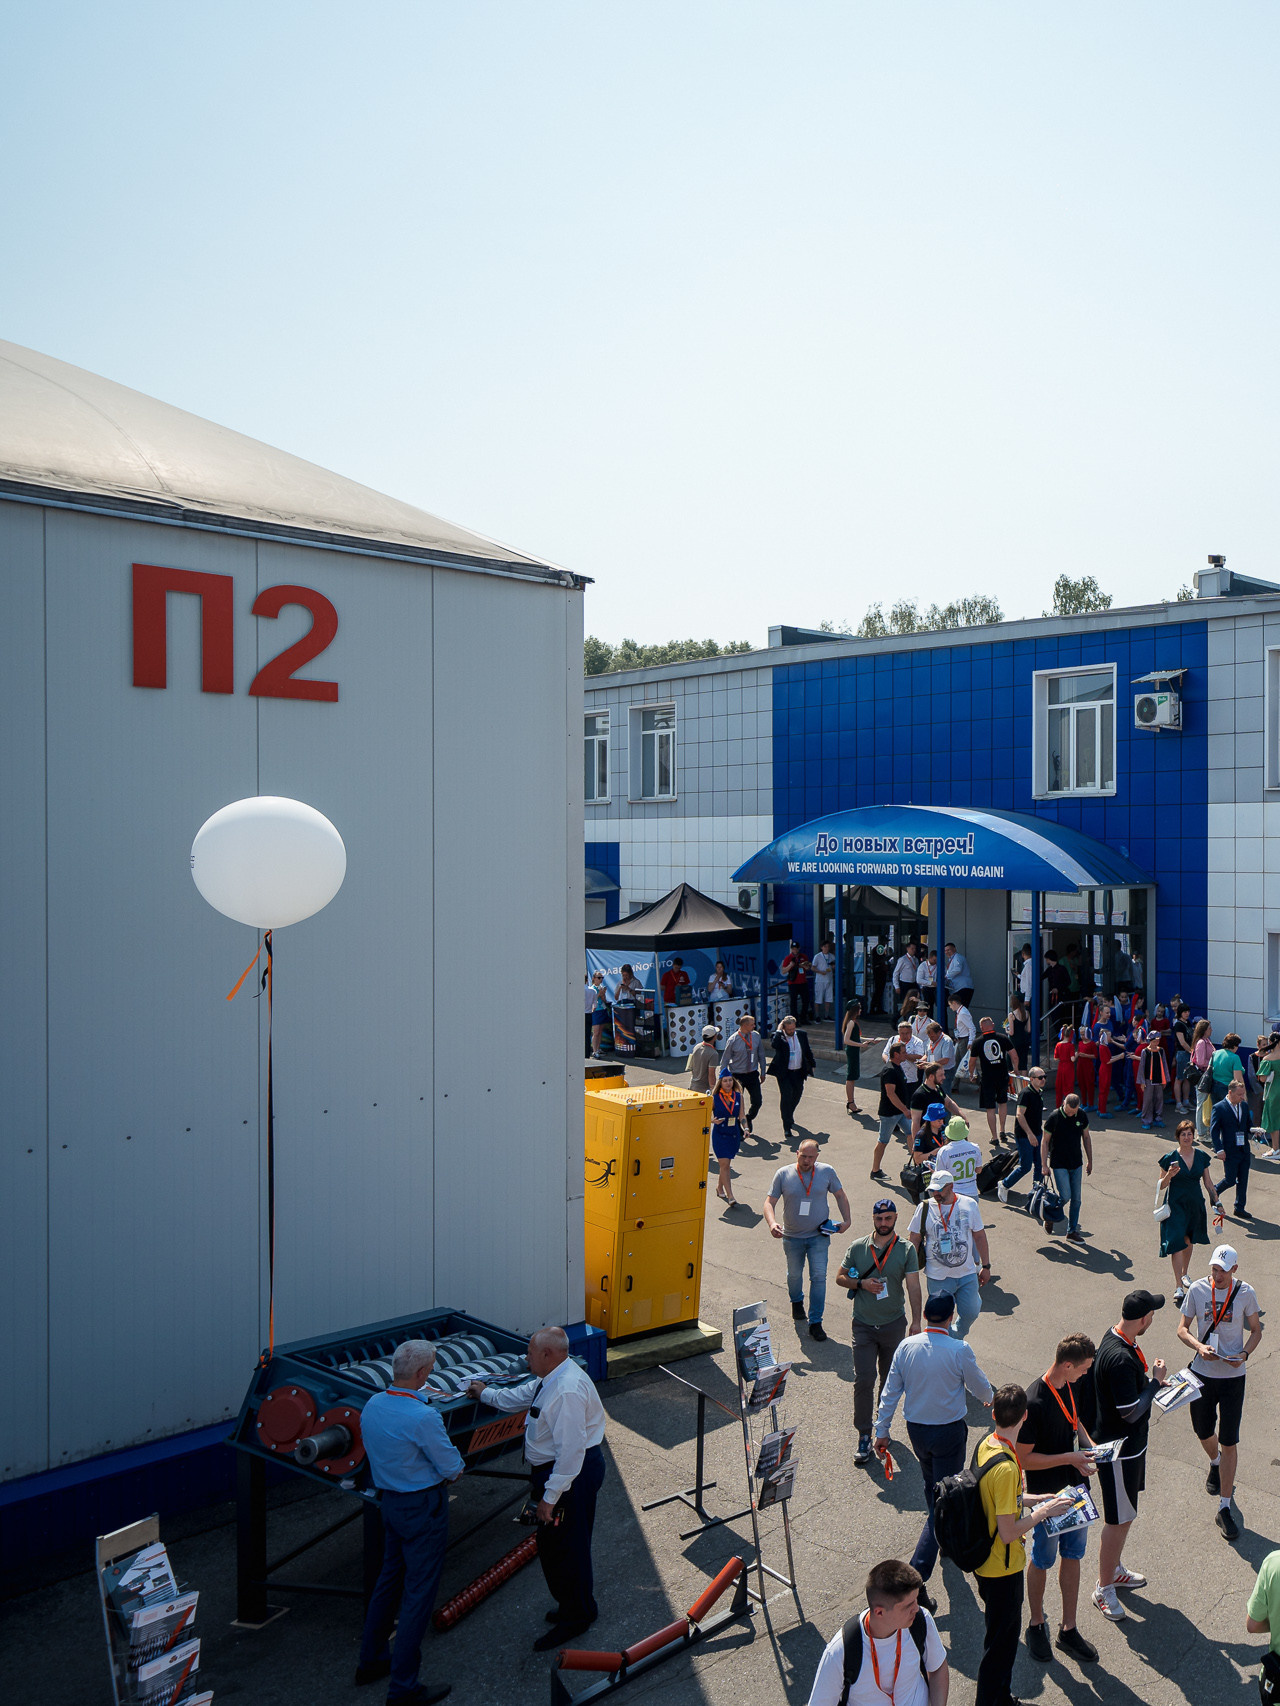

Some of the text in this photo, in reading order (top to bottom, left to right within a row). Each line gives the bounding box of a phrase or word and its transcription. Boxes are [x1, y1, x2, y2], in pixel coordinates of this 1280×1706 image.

[131, 563, 339, 702] П2
[815, 832, 975, 860] До новых встреч!
[788, 862, 1004, 878] WE ARE LOOKING FORWARD TO SEEING YOU AGAIN!
[722, 951, 757, 974] VISIT
[952, 1157, 975, 1181] 30
[472, 1417, 518, 1449] ТИТАН
